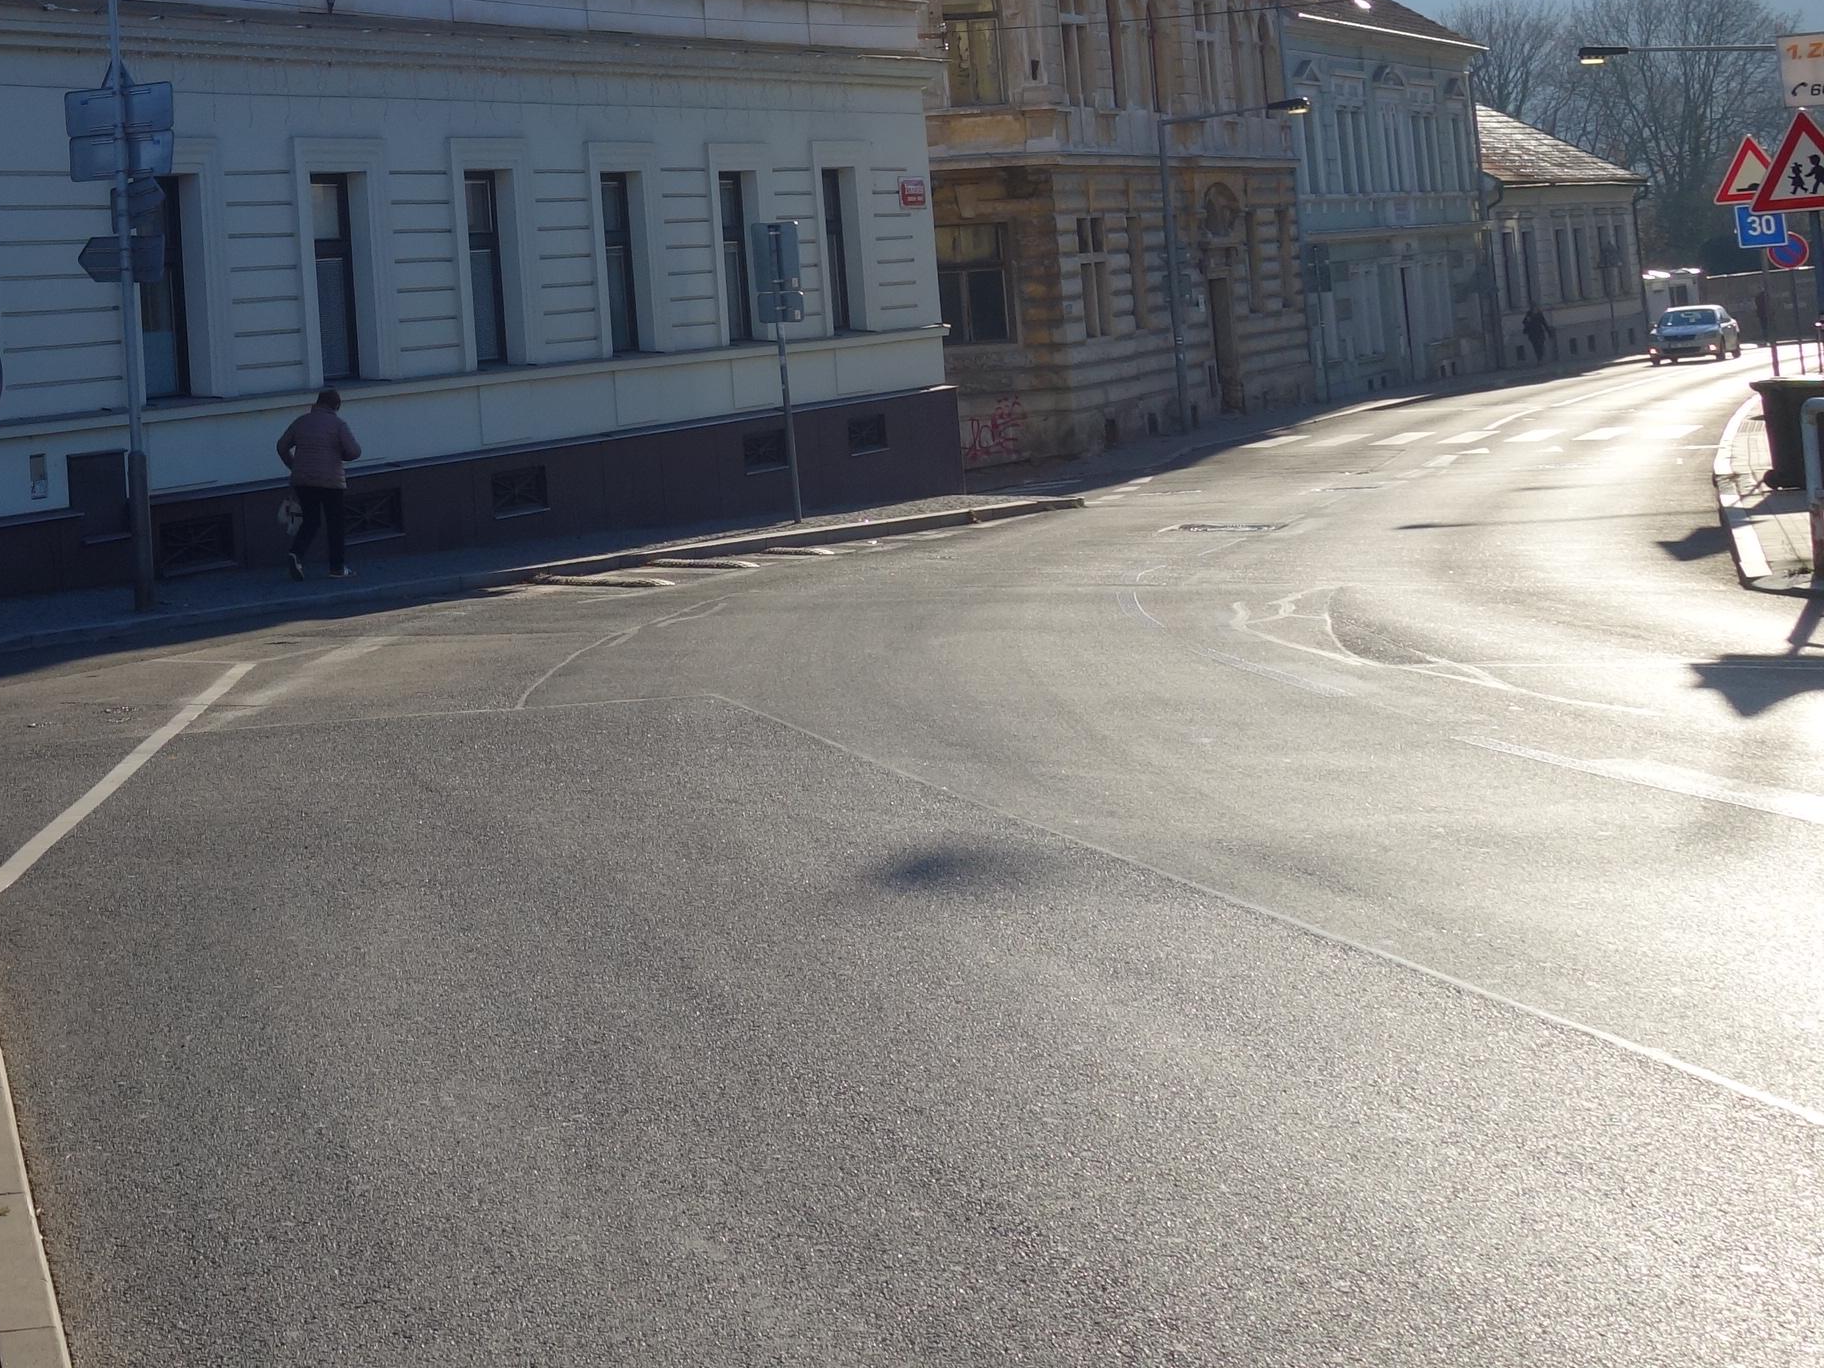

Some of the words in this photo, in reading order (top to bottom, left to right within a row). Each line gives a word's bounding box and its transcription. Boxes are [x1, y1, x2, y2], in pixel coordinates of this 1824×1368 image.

[1807, 41, 1824, 59] Z
[1810, 83, 1824, 96] 6
[1747, 215, 1775, 236] 30
